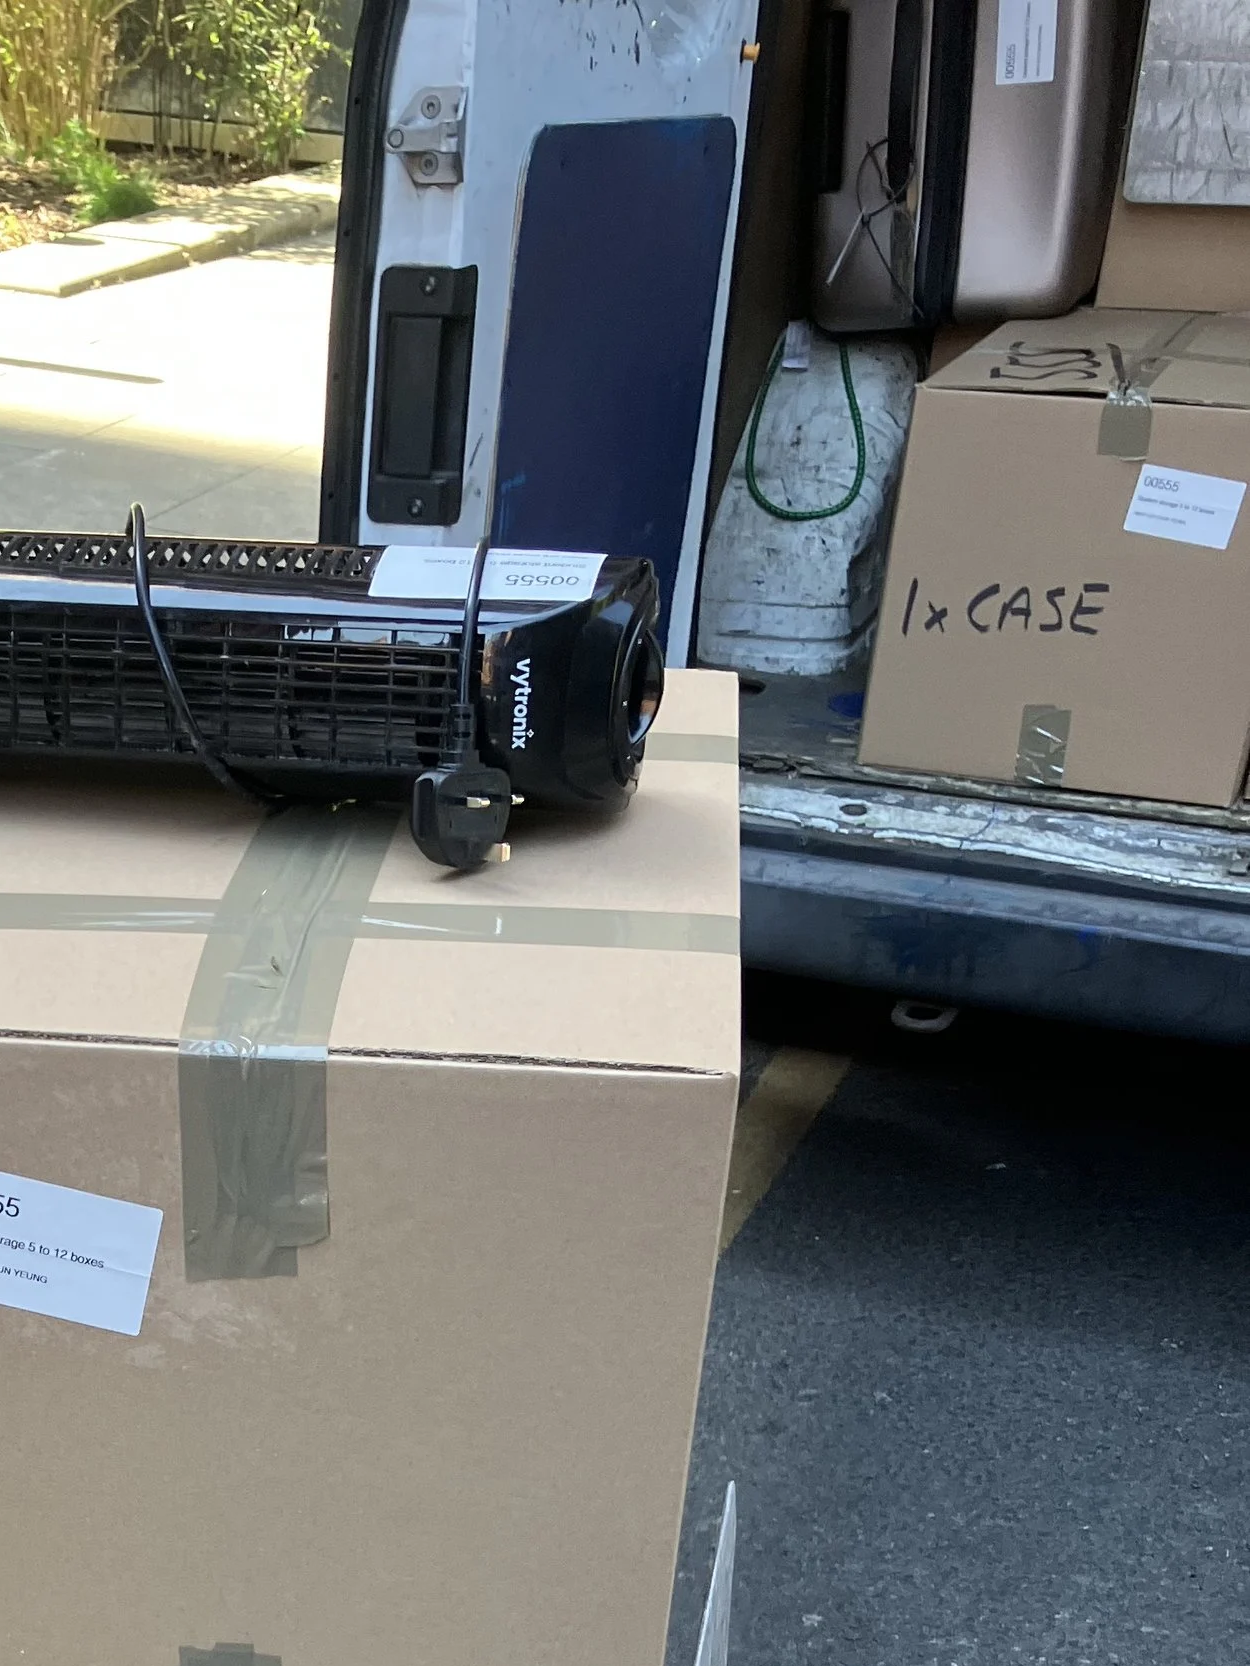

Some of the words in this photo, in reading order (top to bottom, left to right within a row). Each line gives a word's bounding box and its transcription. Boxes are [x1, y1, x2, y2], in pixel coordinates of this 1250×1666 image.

[1144, 476, 1179, 492] 00555
[506, 575, 579, 586] 00555
[967, 583, 1109, 634] CASE
[510, 658, 534, 749] vytronix
[28, 1242, 35, 1252] 5
[39, 1245, 50, 1255] to
[55, 1248, 67, 1259] 12
[71, 1252, 104, 1268] boxes
[14, 1269, 47, 1284] YEUNG
